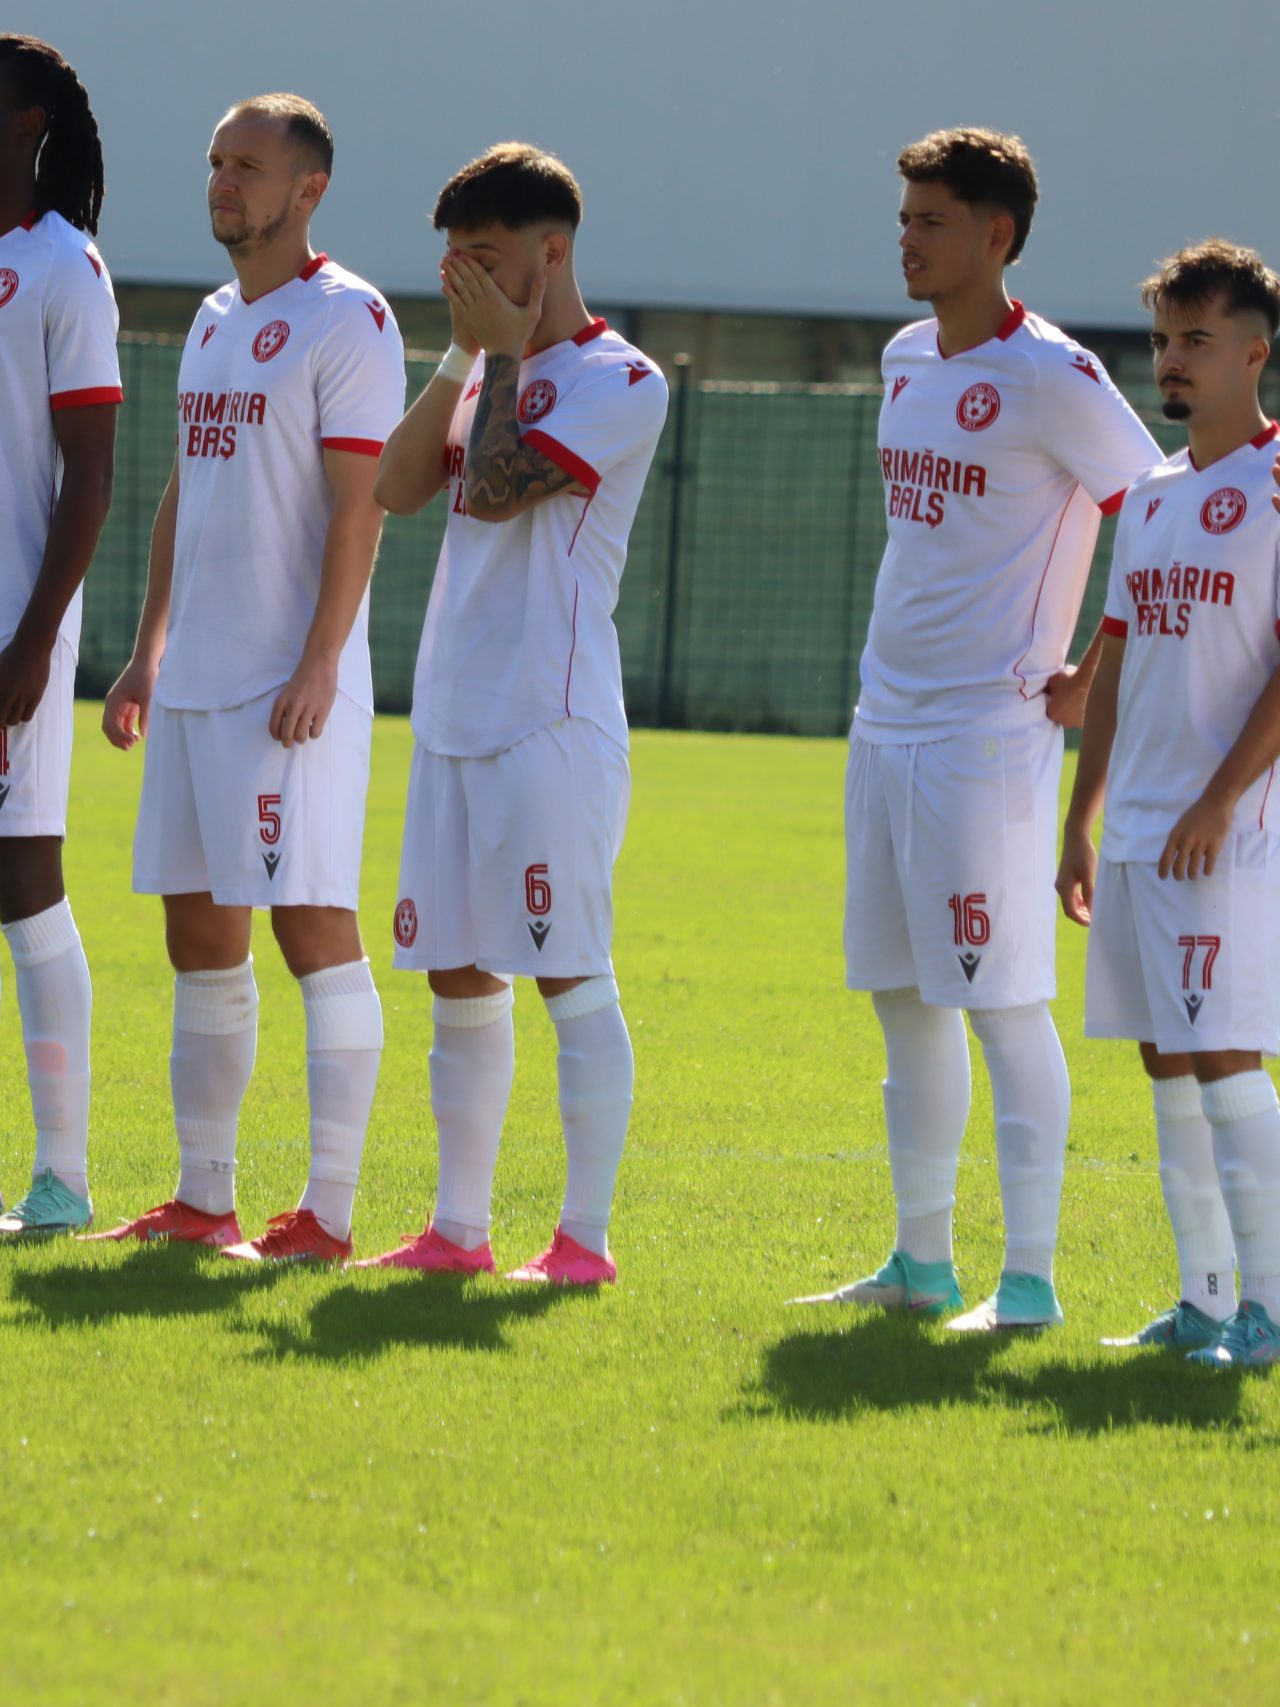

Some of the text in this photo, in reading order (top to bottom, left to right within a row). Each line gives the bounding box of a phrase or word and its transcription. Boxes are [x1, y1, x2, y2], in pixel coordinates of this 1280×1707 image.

[257, 793, 282, 845] 5
[524, 863, 552, 916] 6
[947, 892, 991, 946] 16
[1177, 934, 1221, 990] 77
